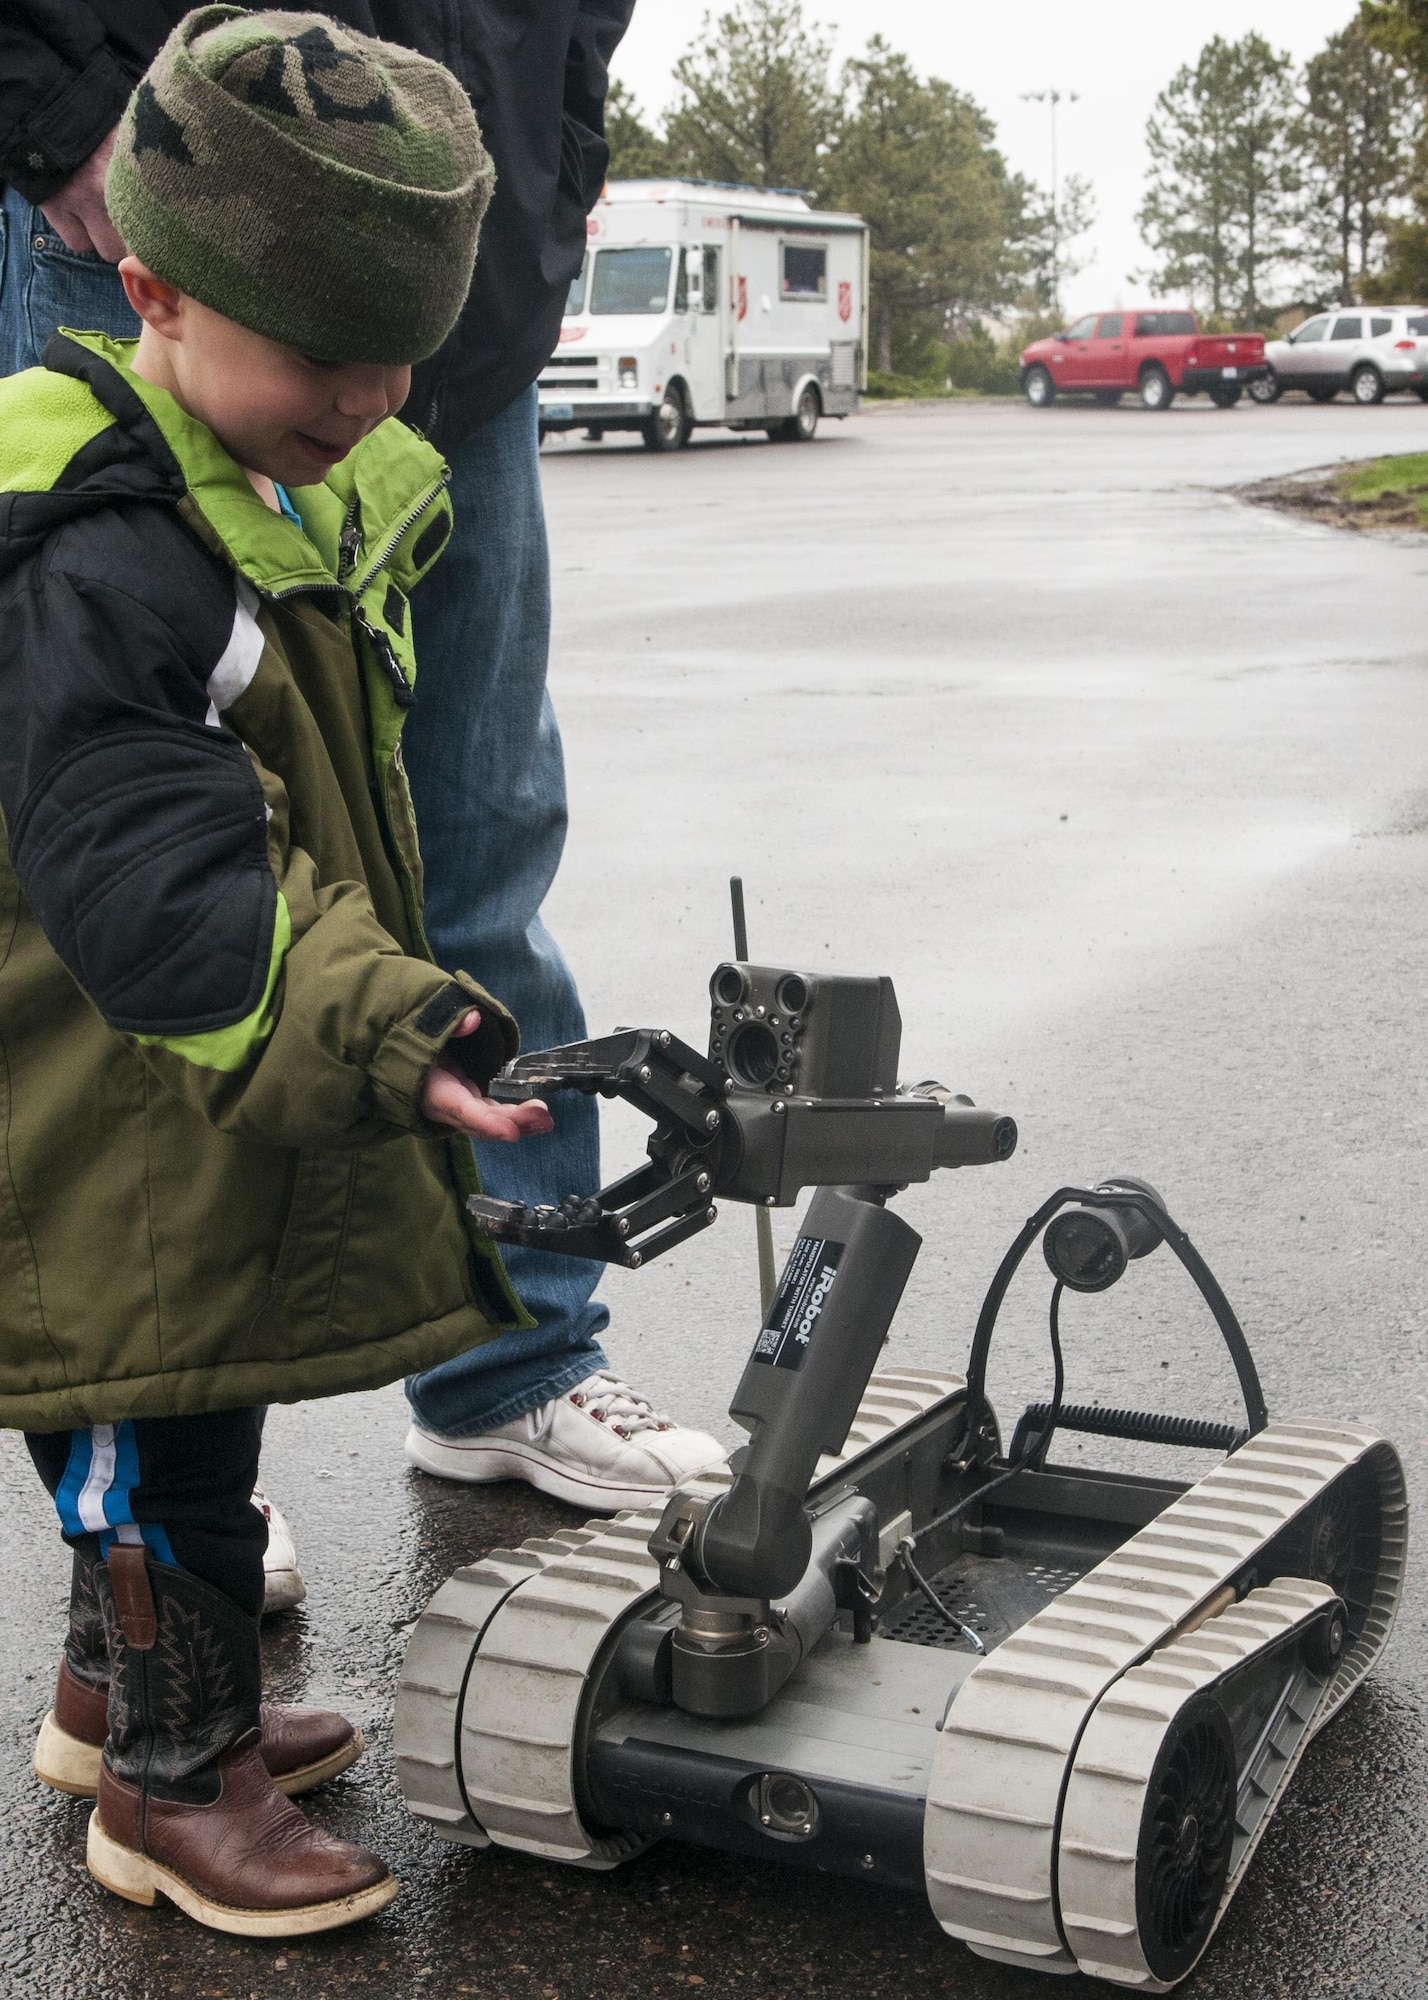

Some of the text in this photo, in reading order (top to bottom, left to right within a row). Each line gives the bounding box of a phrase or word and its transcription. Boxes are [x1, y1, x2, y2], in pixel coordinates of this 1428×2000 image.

[797, 1240, 820, 1285] MANIPULATOR
[780, 1305, 794, 1329] TURRET
[790, 1286, 801, 1304] WITH
[792, 1276, 816, 1328] www.irobot.com
[795, 1265, 838, 1345] iRobot
